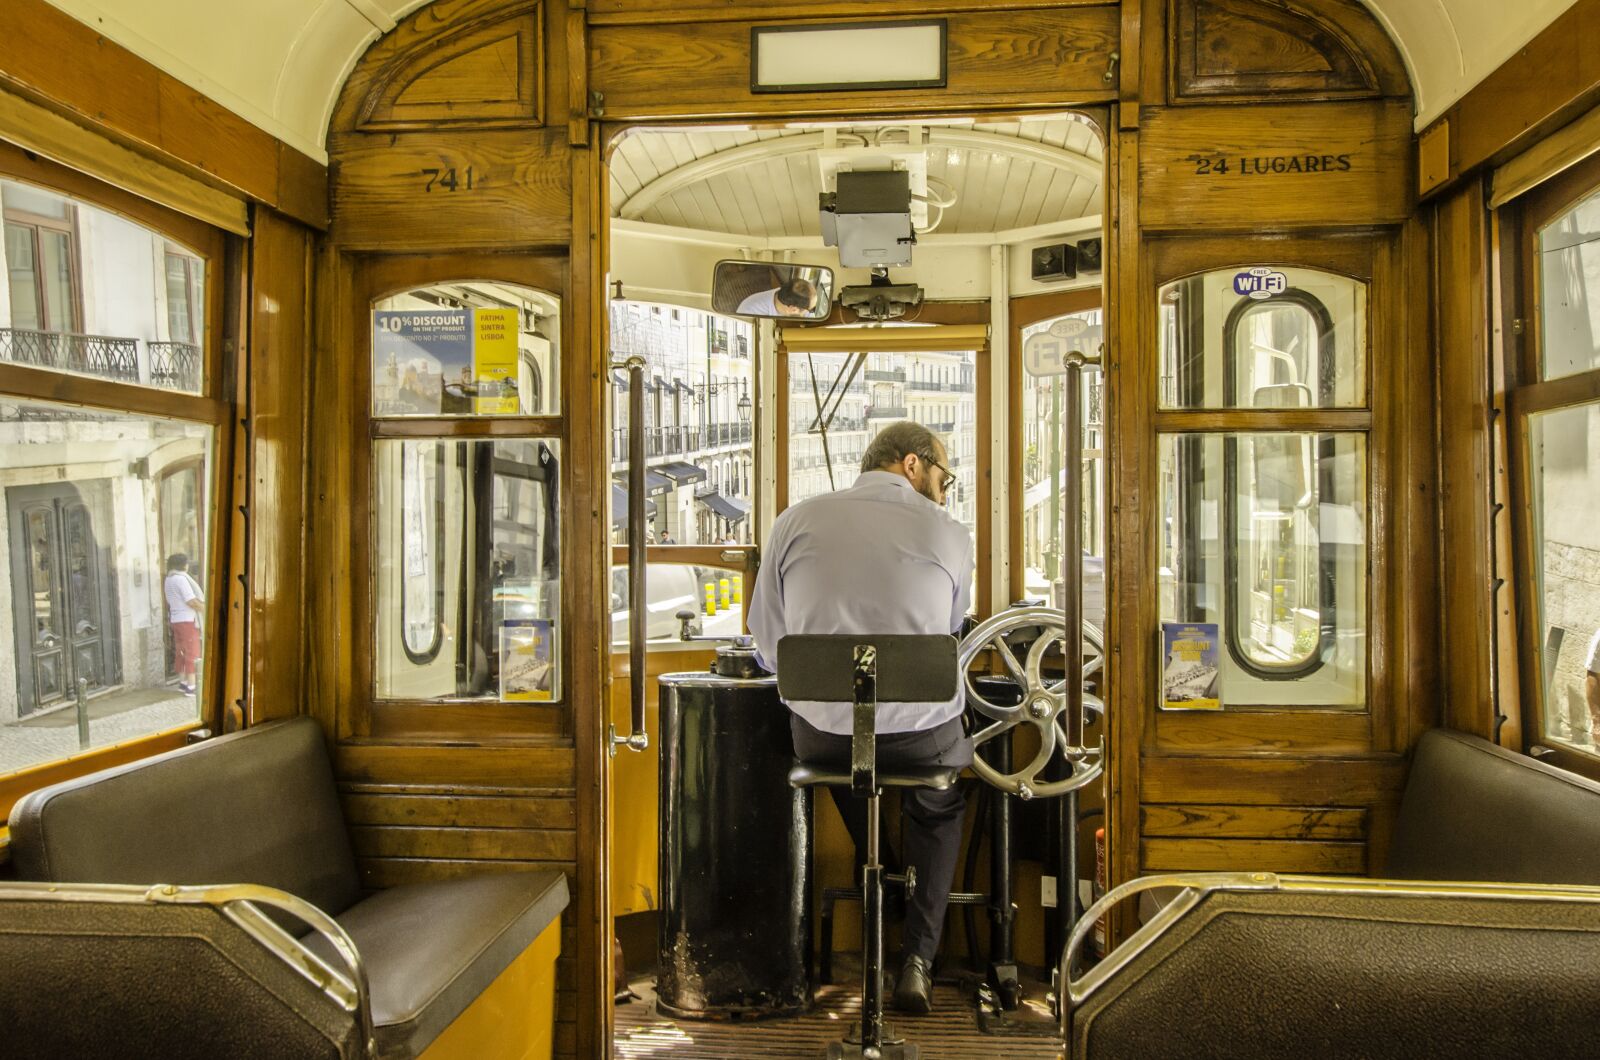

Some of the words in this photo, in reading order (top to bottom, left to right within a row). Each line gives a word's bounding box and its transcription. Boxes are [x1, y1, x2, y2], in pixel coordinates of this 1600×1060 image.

[1196, 158, 1229, 175] 24
[1240, 154, 1352, 175] LUGARES
[421, 166, 473, 192] 741
[413, 316, 465, 326] DISCOUNT
